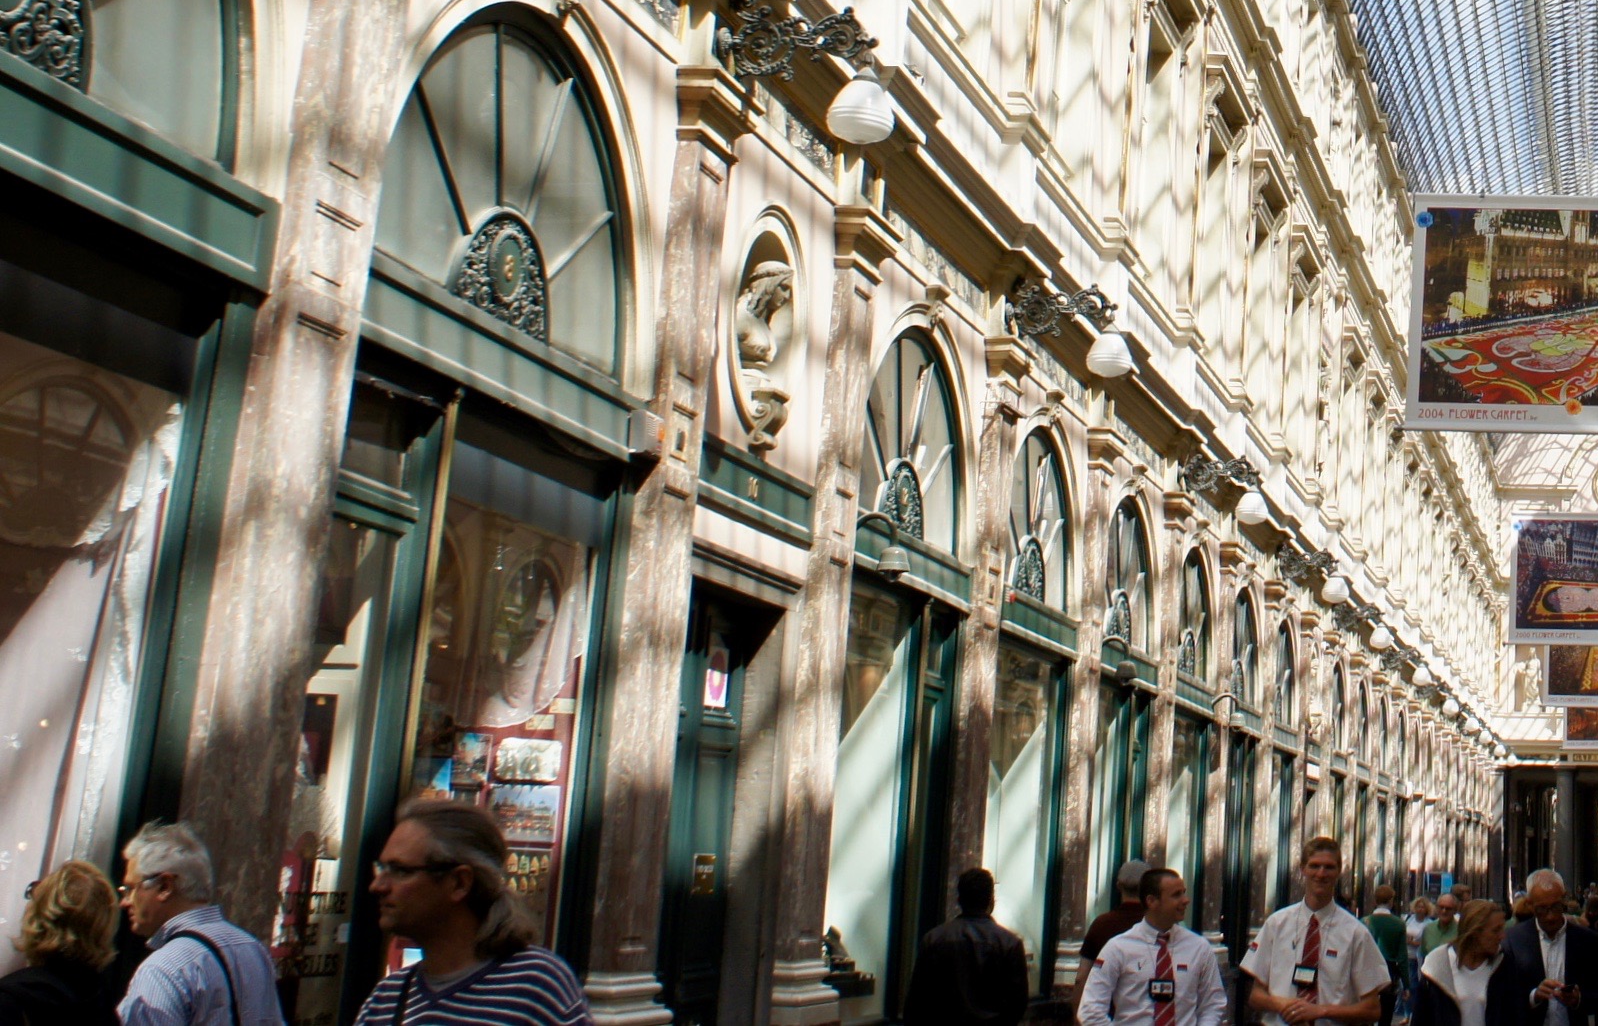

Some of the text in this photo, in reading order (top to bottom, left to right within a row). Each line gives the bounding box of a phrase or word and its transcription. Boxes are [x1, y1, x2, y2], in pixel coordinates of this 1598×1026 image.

[504, 254, 515, 281] 8
[1418, 408, 1444, 419] 2004
[1448, 409, 1488, 420] FLOWER
[1490, 409, 1529, 420] CARPET
